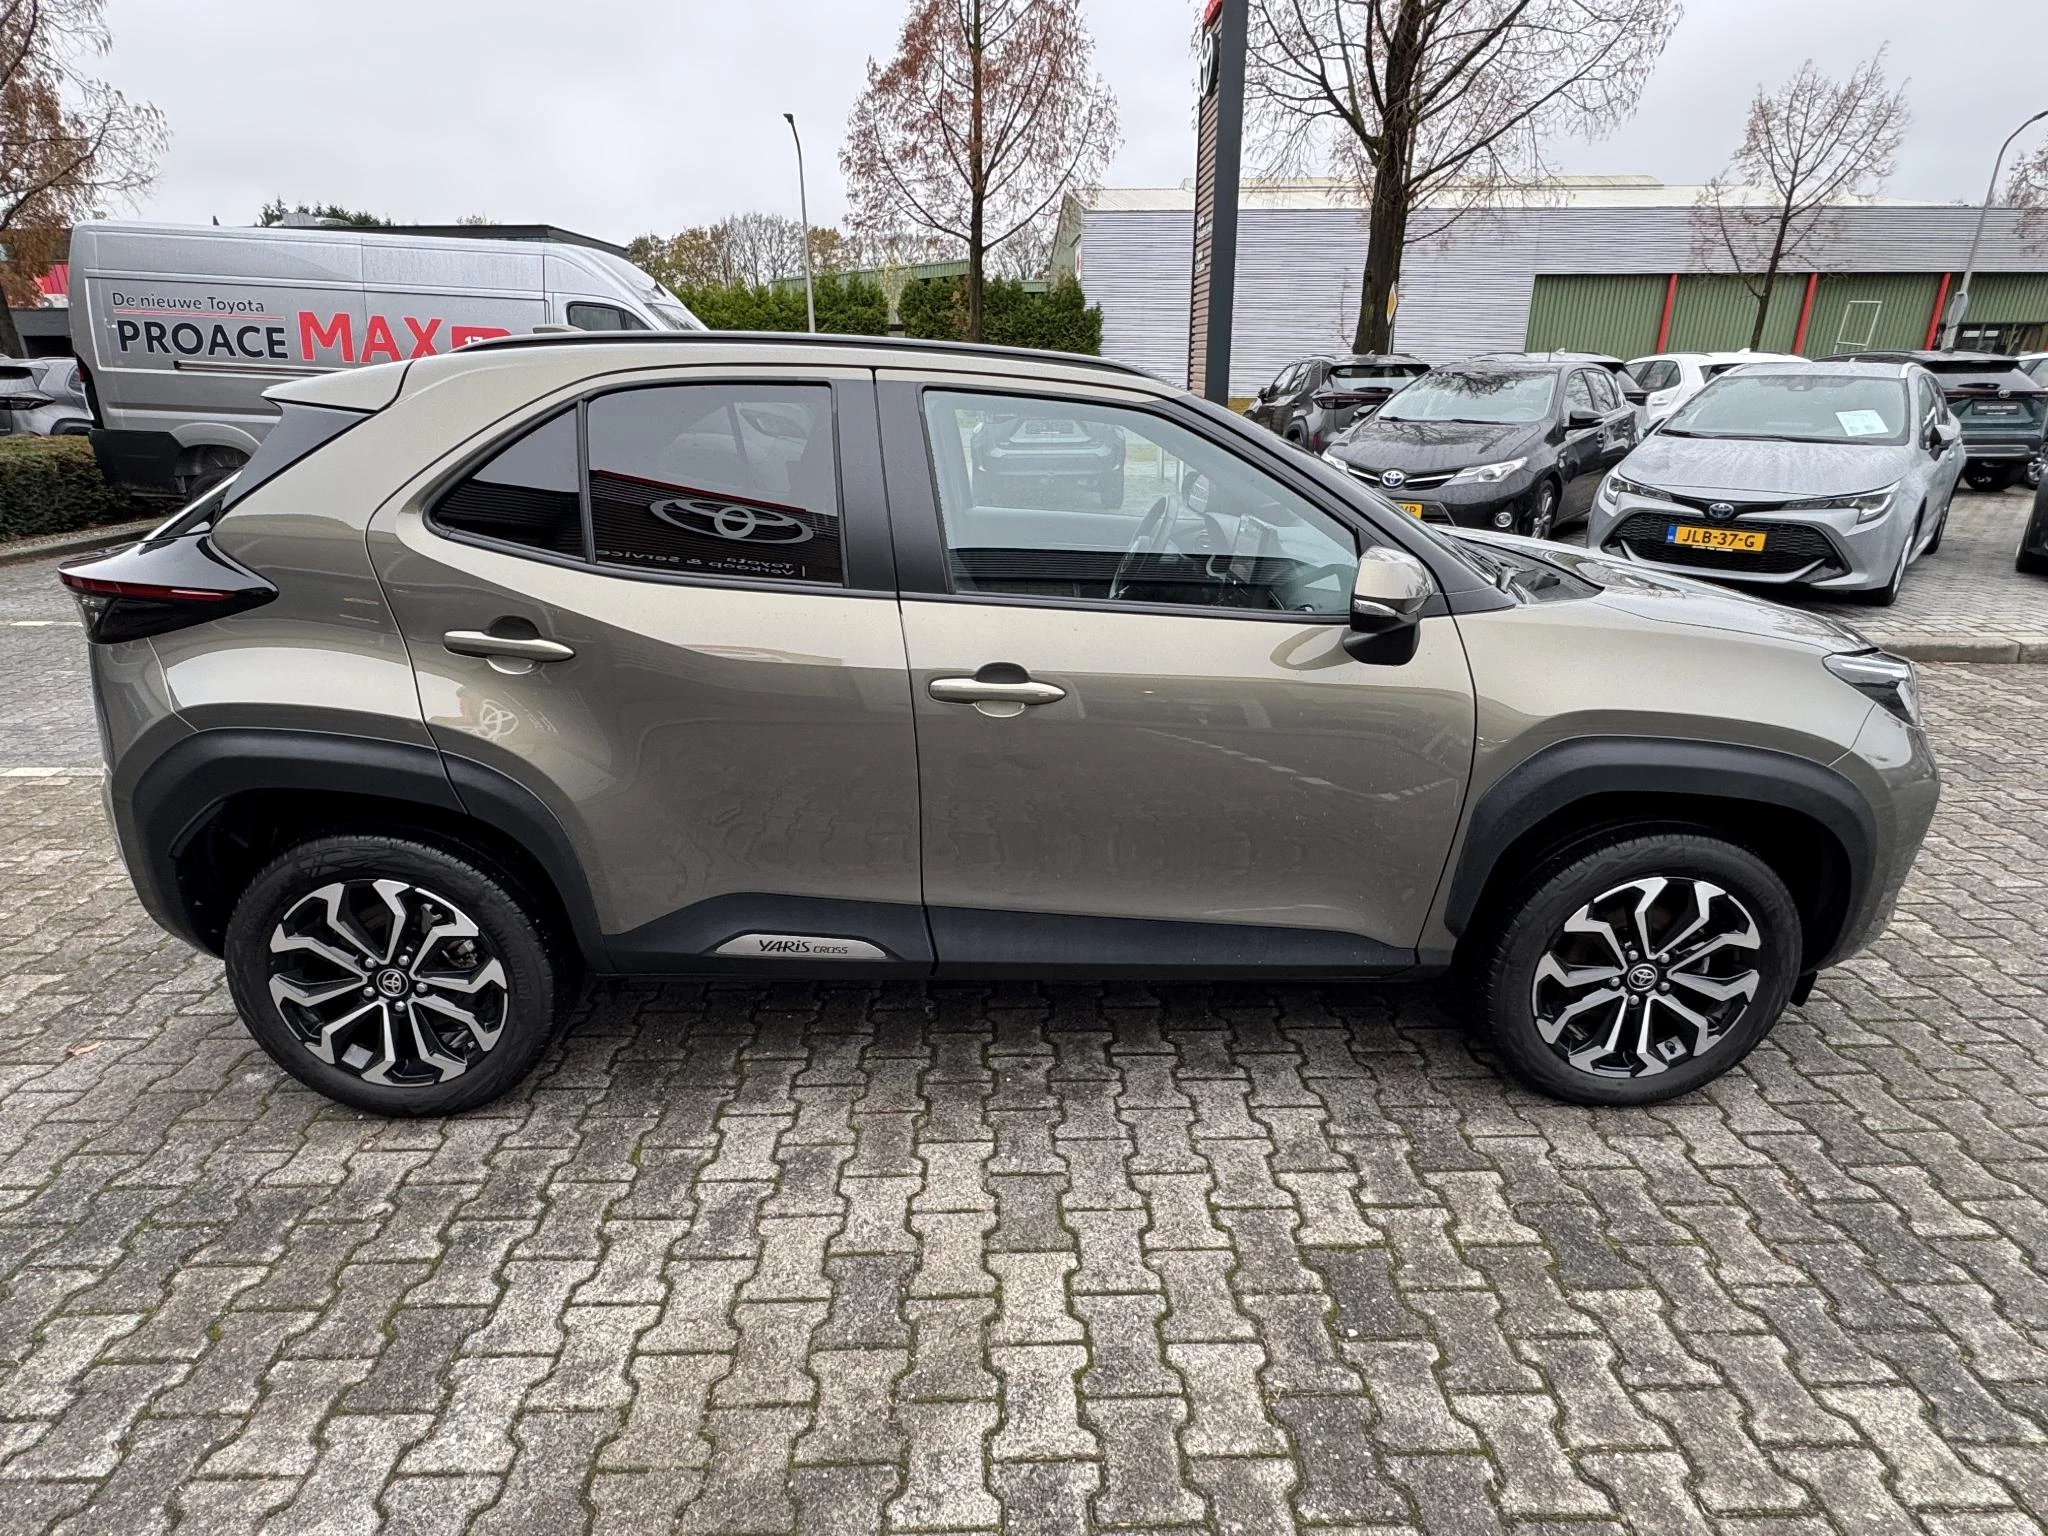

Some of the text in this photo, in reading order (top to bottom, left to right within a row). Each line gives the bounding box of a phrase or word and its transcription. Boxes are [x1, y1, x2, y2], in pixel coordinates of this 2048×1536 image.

[112, 292, 265, 314] De nieuwe Toyota
[116, 310, 443, 364] PROACE MAX
[1682, 529, 1756, 548] JLB-37-G
[813, 945, 848, 954] CROSS
